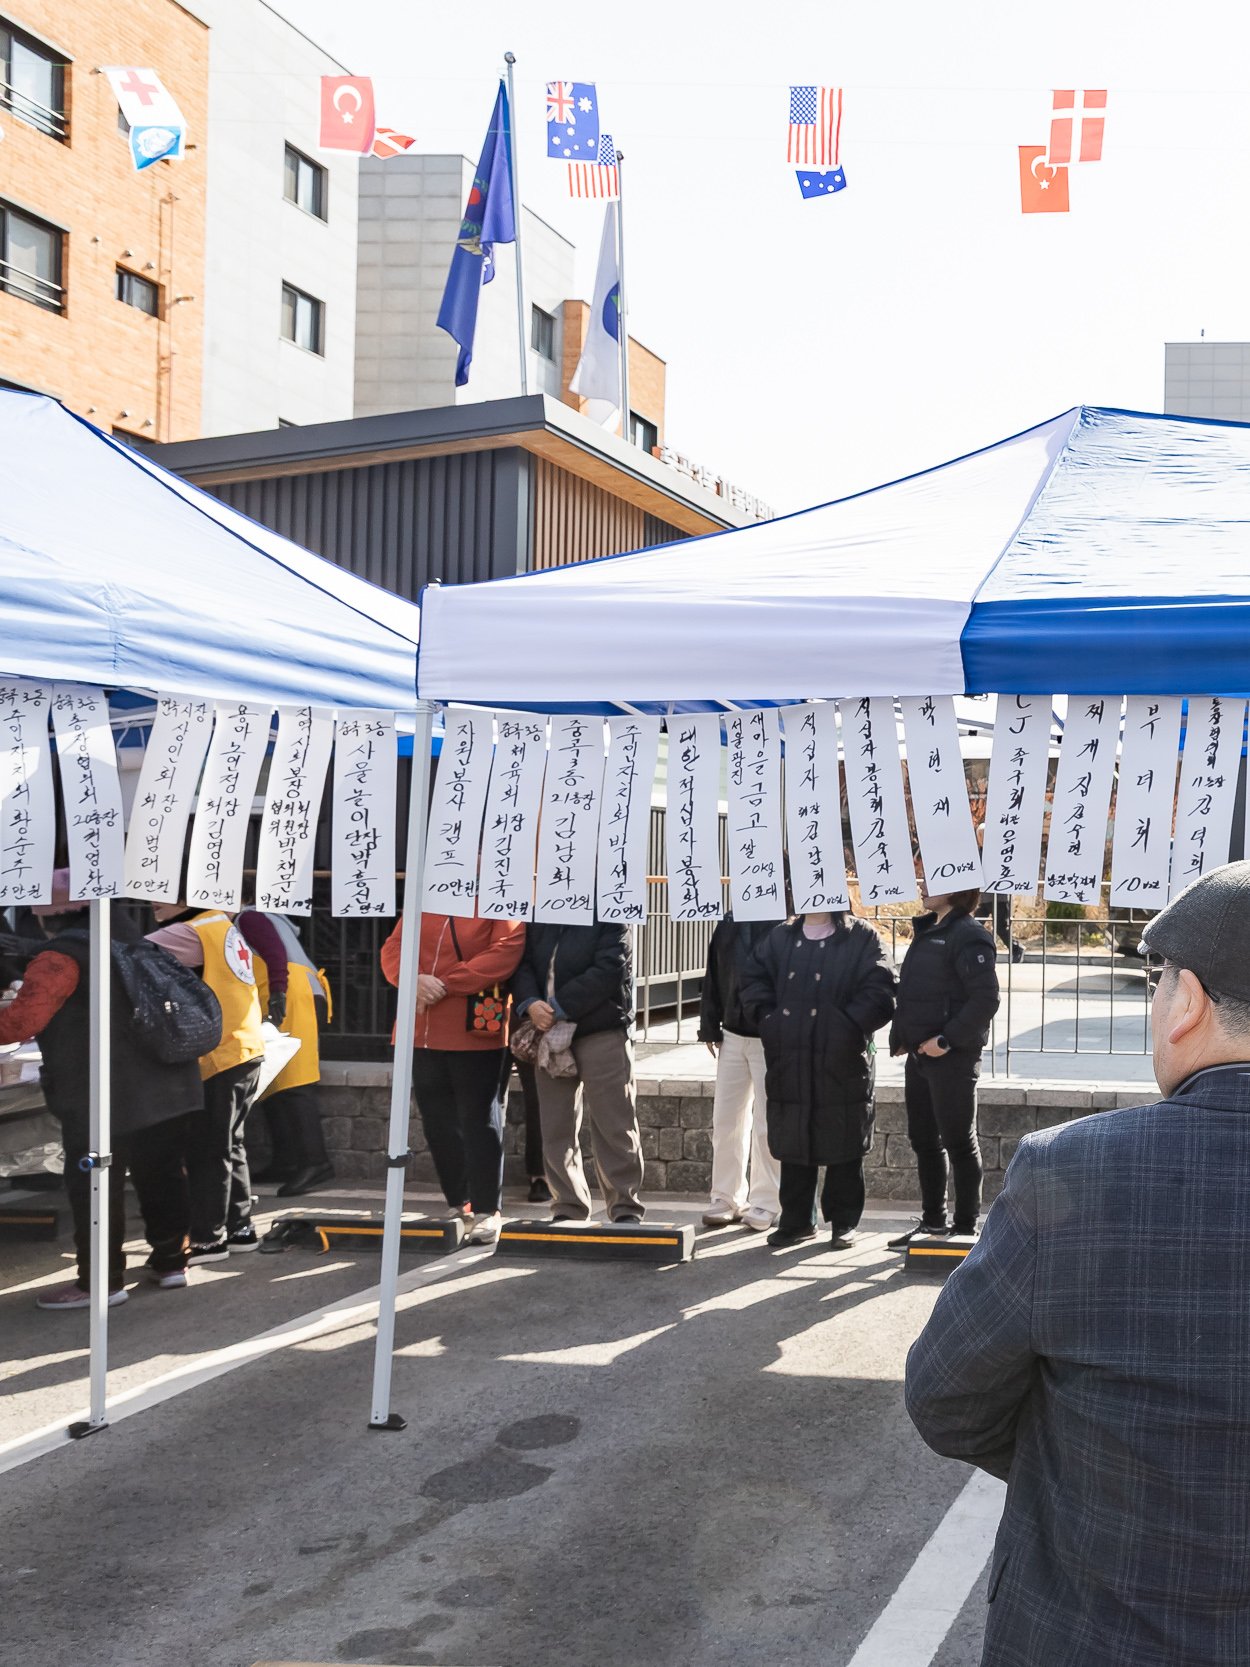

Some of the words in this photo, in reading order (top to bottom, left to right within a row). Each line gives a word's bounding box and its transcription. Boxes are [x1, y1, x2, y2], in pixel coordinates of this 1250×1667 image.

[126, 880, 170, 893] 10만원
[192, 889, 234, 905] 10만원
[541, 895, 593, 910] 10만원
